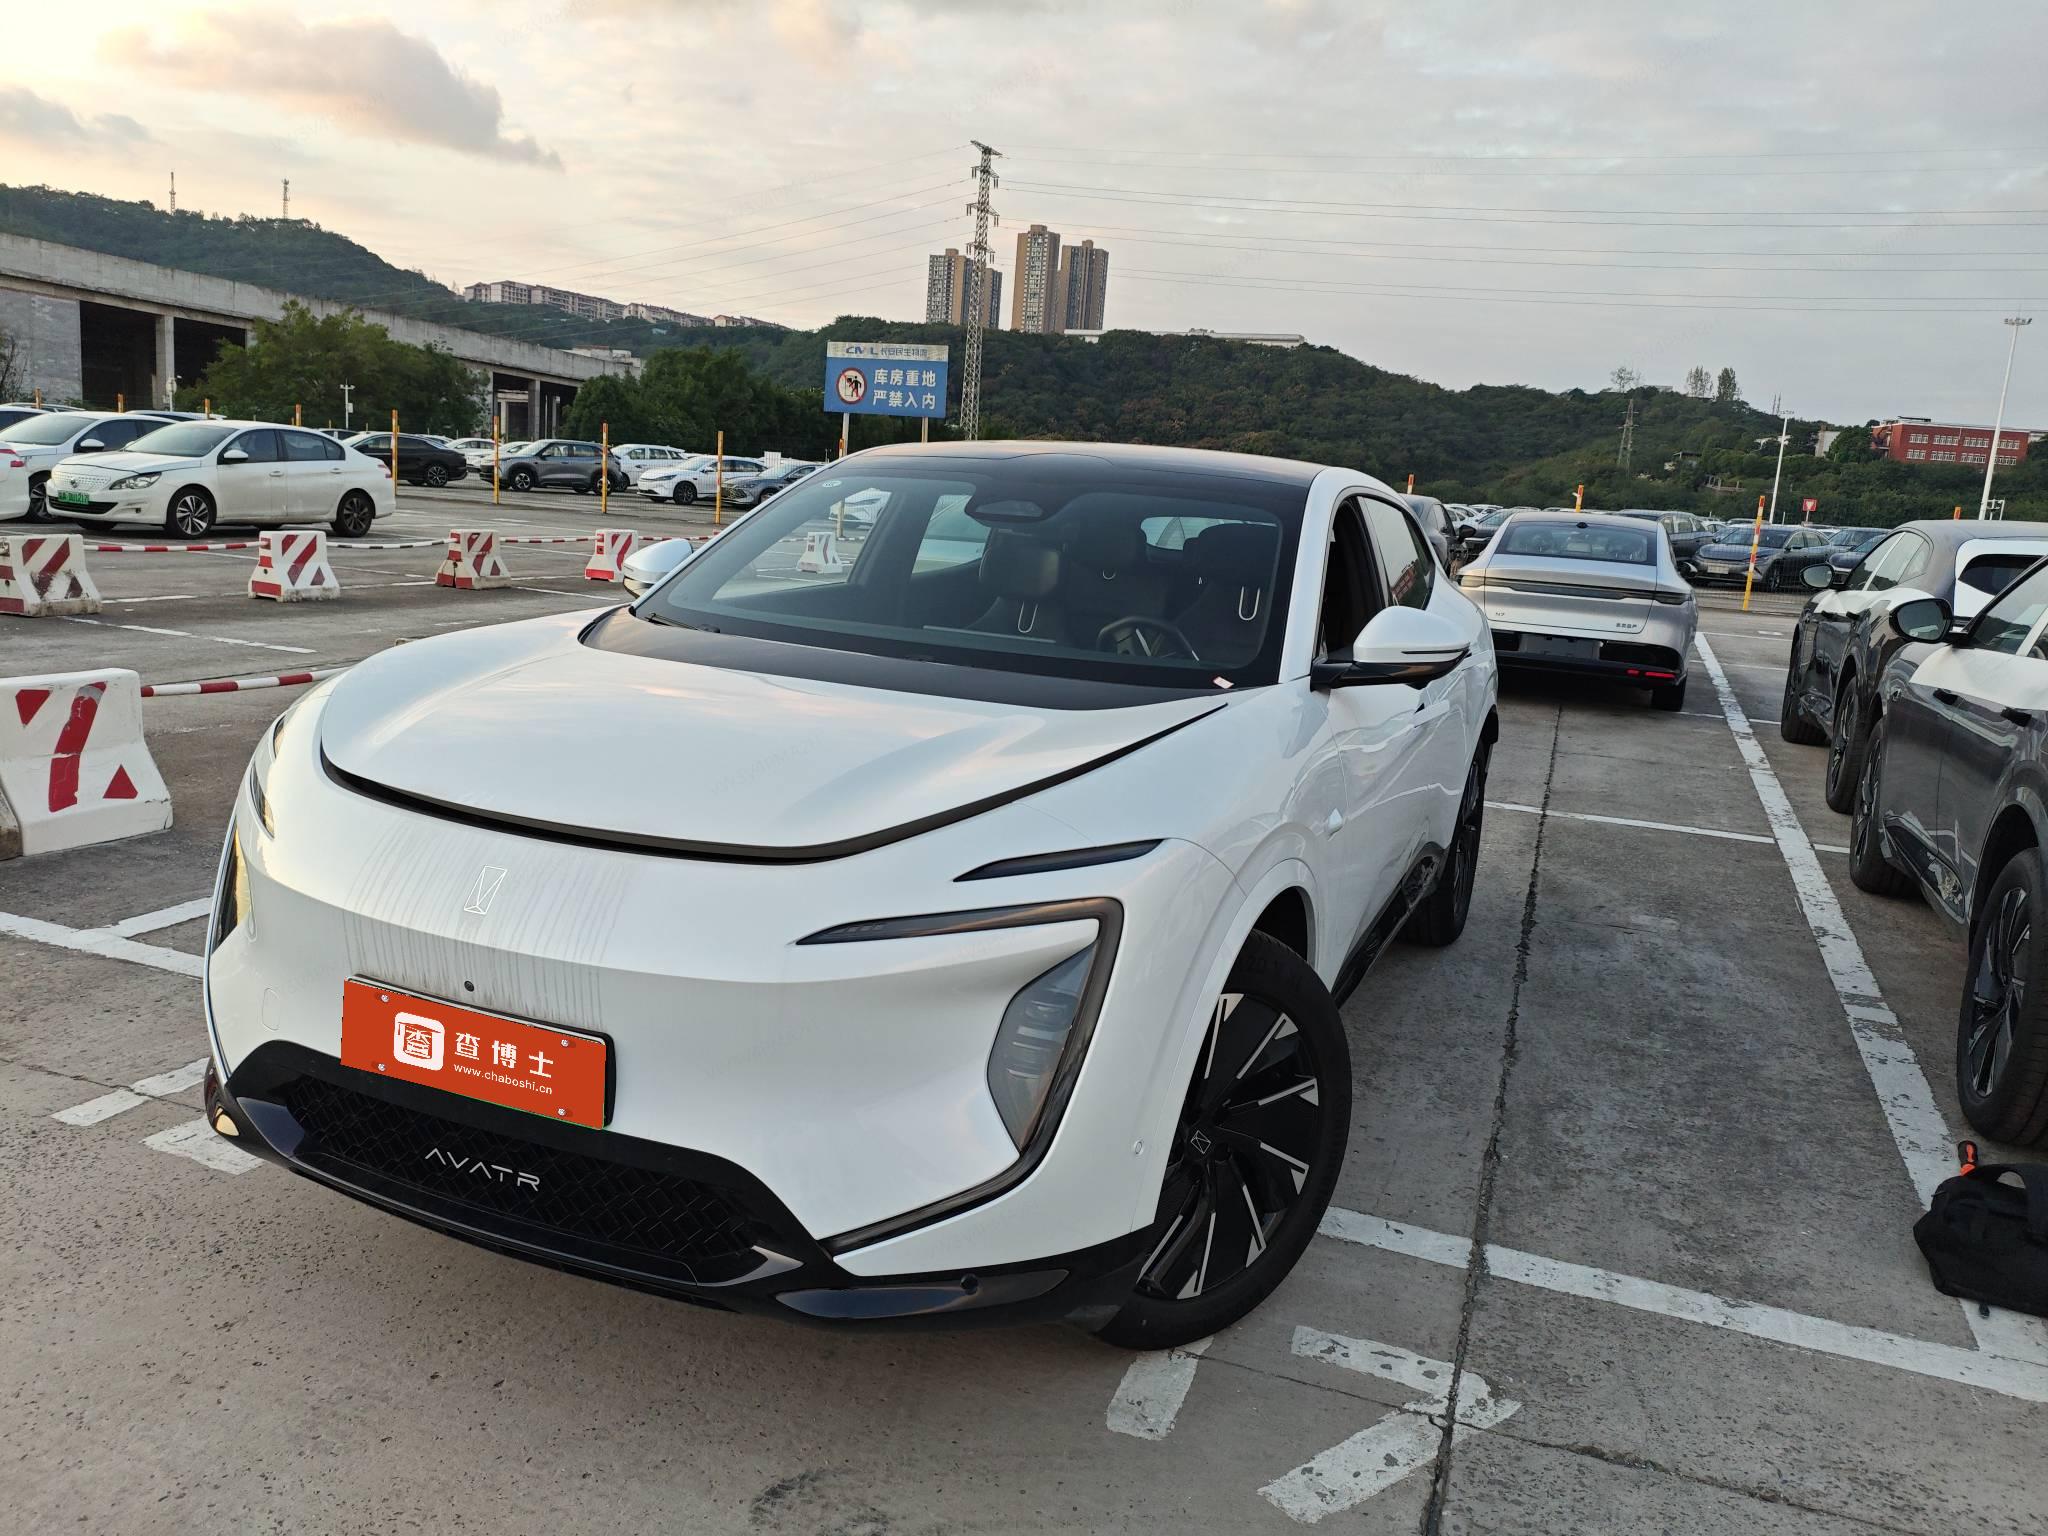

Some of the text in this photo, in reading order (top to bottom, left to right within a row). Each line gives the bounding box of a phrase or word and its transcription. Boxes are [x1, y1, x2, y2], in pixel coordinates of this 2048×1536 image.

[873, 367, 937, 388] 库房重地
[872, 389, 936, 410] 严禁入内
[424, 1147, 541, 1192] AVATR
